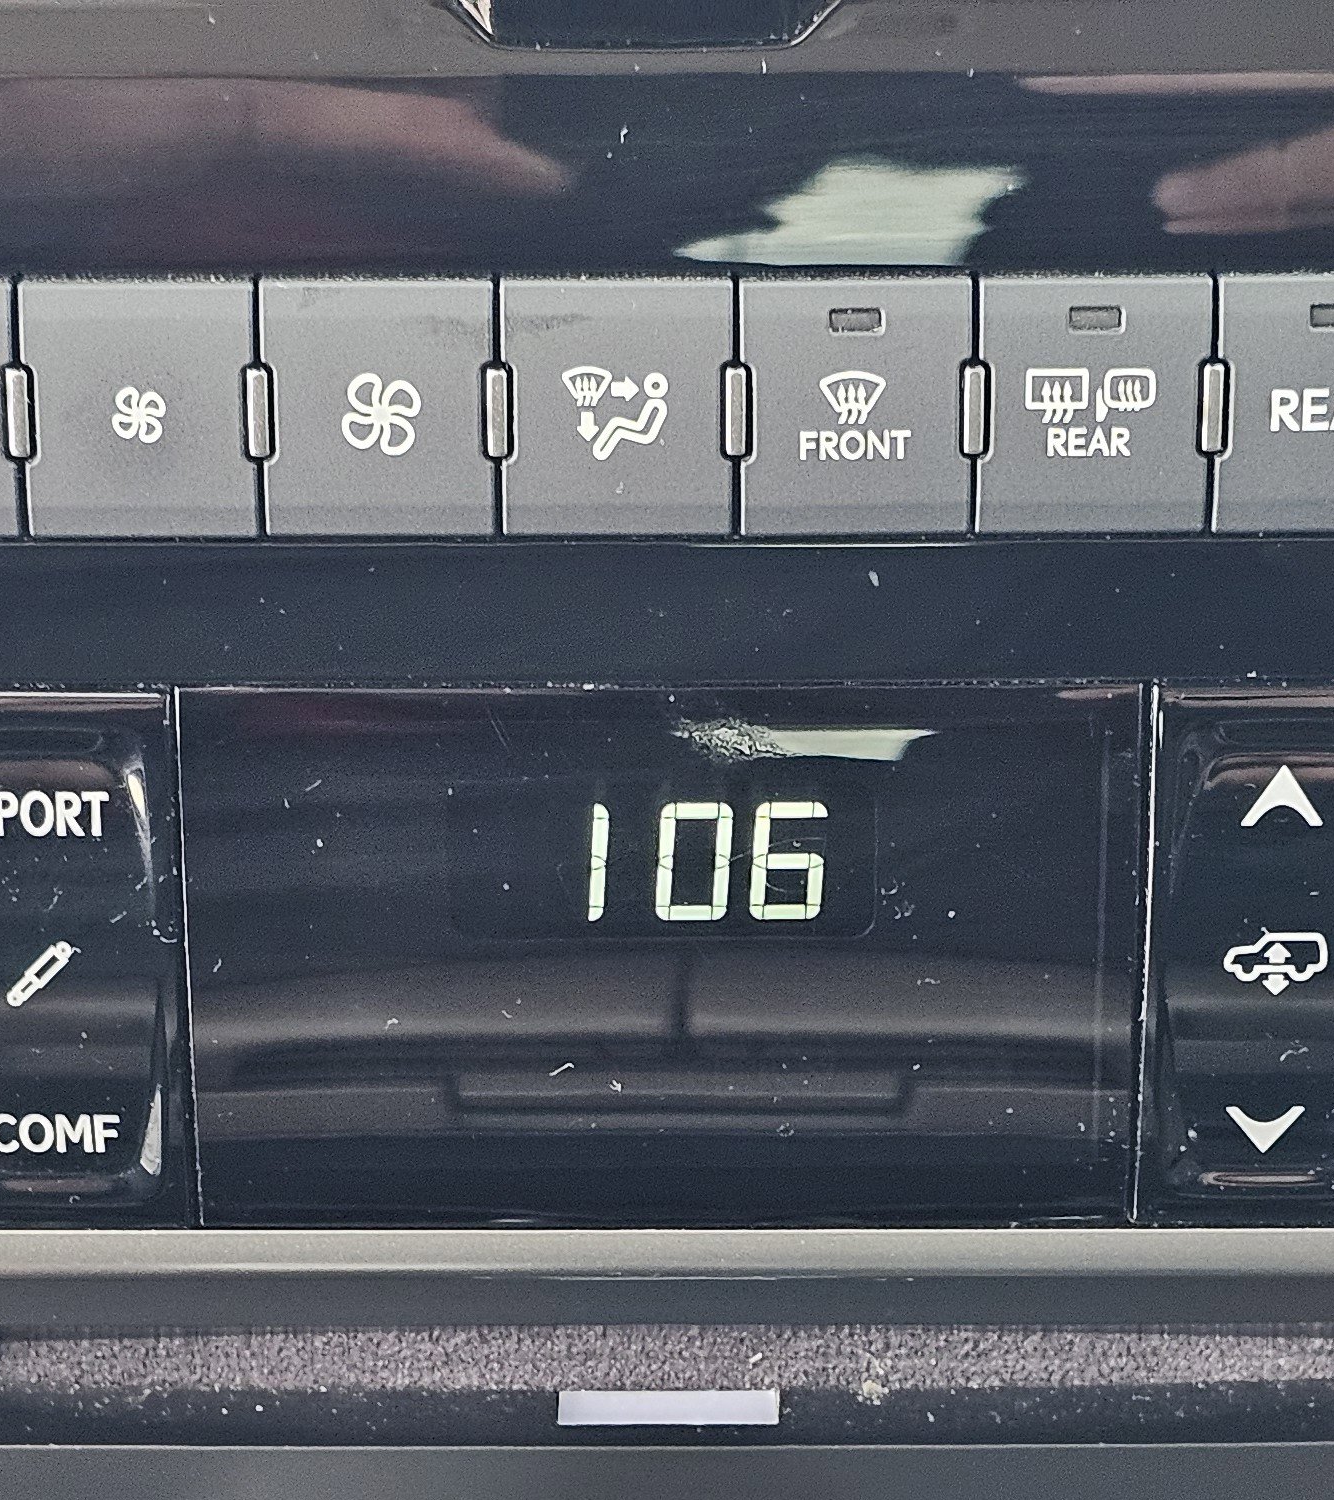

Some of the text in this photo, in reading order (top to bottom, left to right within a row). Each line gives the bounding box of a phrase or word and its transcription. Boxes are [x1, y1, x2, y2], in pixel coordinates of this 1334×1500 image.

[799, 428, 912, 461] FRONT
[1047, 425, 1131, 457] REAR
[587, 801, 829, 922] 106
